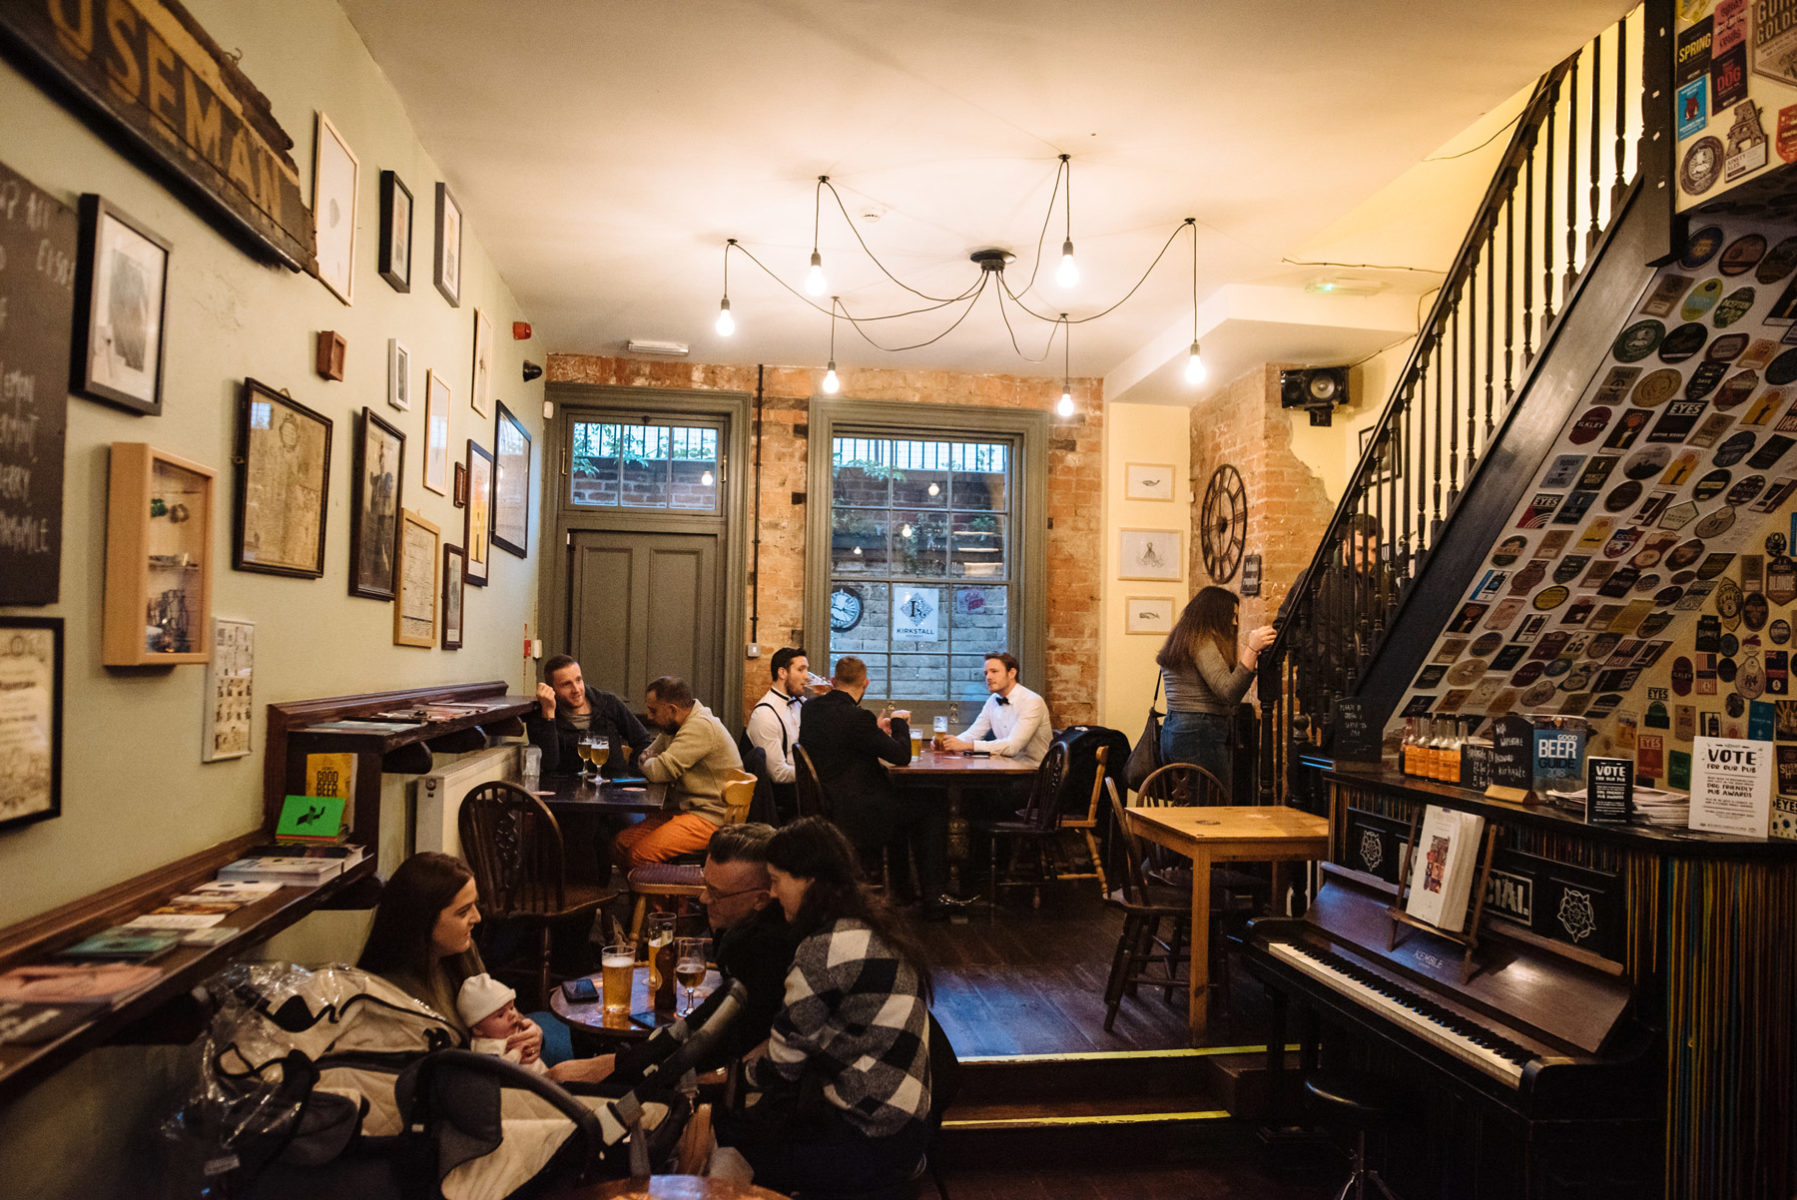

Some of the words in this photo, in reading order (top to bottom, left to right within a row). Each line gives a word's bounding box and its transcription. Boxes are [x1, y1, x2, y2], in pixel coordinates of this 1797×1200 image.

[1679, 33, 1711, 62] SPRING
[1717, 66, 1741, 92] DOG
[1668, 403, 1702, 414] EYES
[1769, 576, 1796, 591] BLONDE
[1648, 689, 1669, 699] EYES
[1557, 734, 1578, 742] GOOD
[1538, 739, 1577, 759] BEER
[1538, 757, 1576, 769] GUIDE
[1708, 748, 1757, 766] VOTE
[1596, 765, 1626, 777] VOTE
[1742, 766, 1757, 774] PUB
[317, 771, 338, 783] GOOD
[316, 783, 338, 797] BEER
[1722, 784, 1754, 793] FRIENDLY
[1723, 790, 1752, 799] AWARDS
[1414, 950, 1444, 970] KEMBLE
